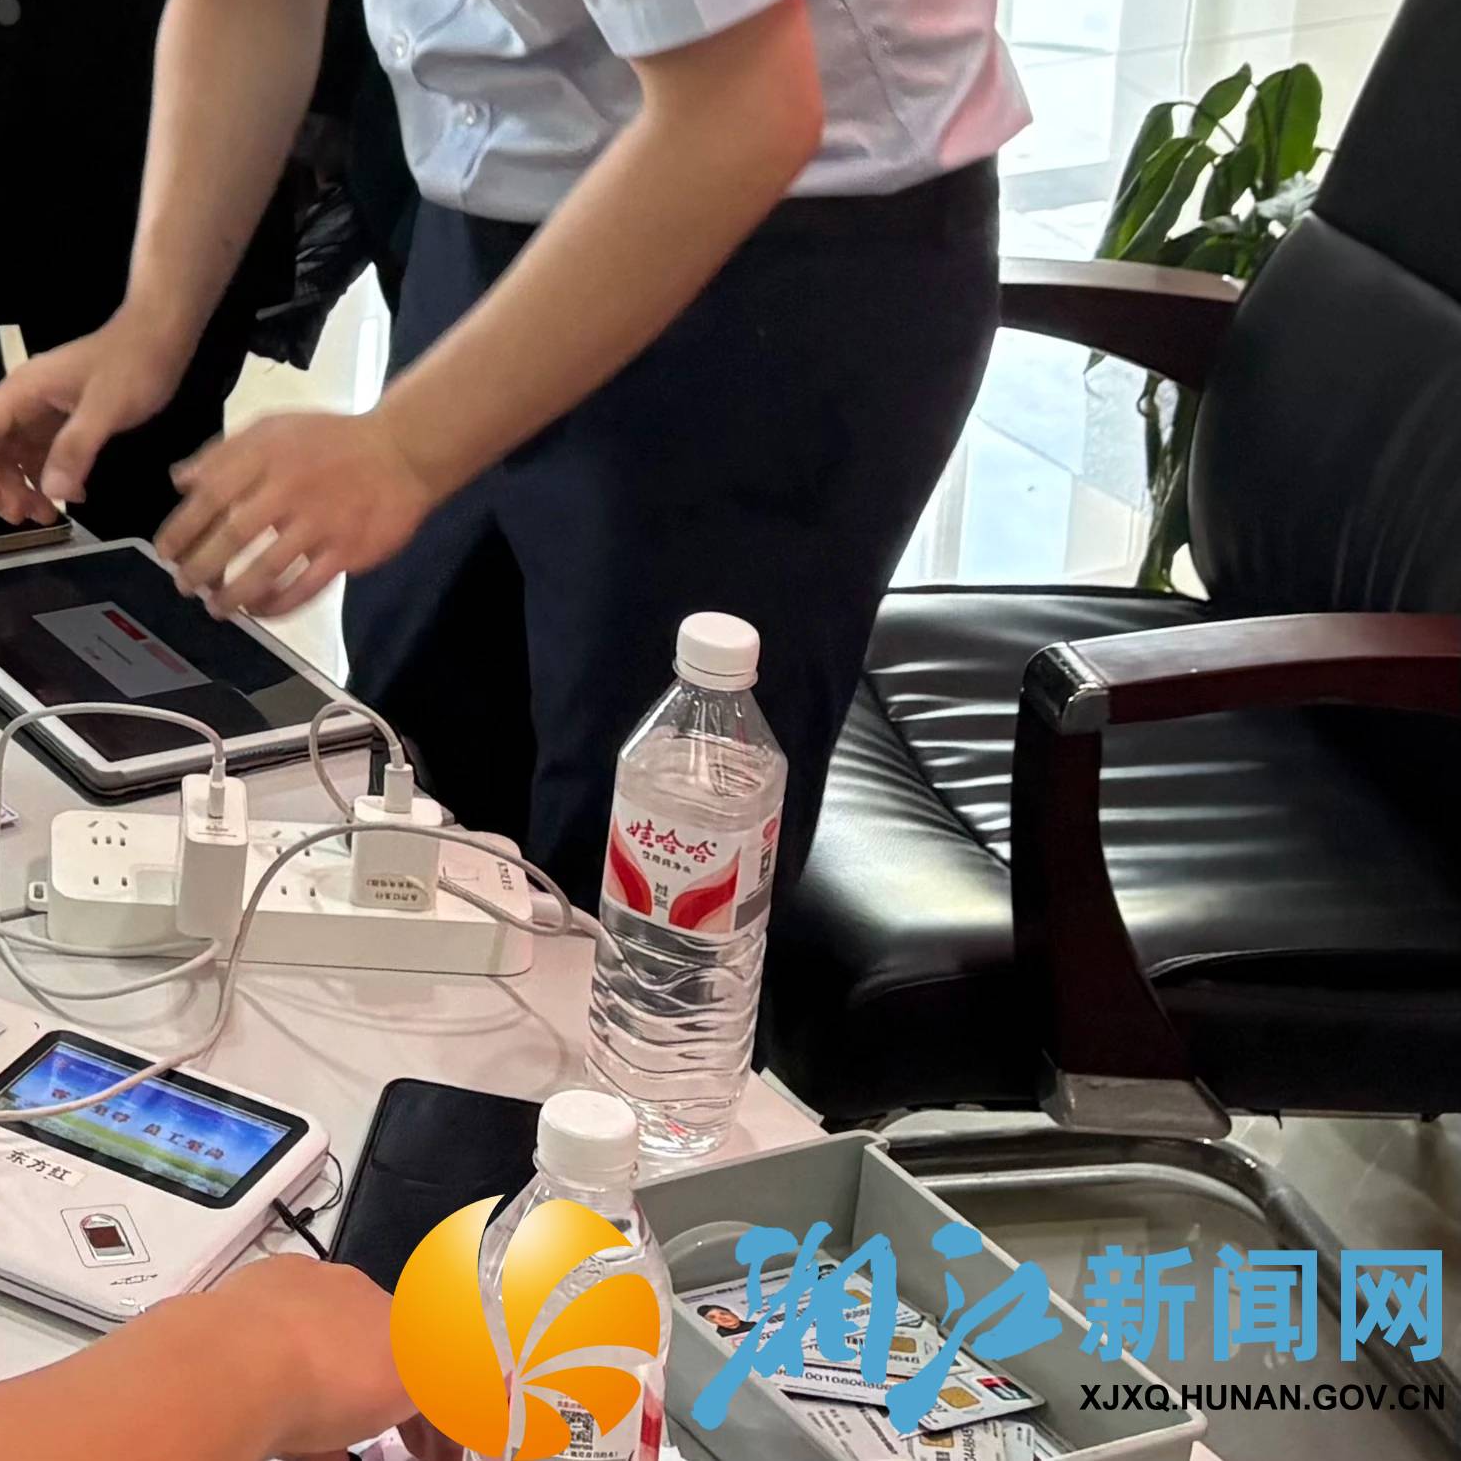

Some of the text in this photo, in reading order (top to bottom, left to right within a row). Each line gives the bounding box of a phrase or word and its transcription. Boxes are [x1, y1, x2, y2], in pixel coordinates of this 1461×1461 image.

[626, 819, 718, 864] 娃哈哈
[6, 1149, 72, 1182] 东方红
